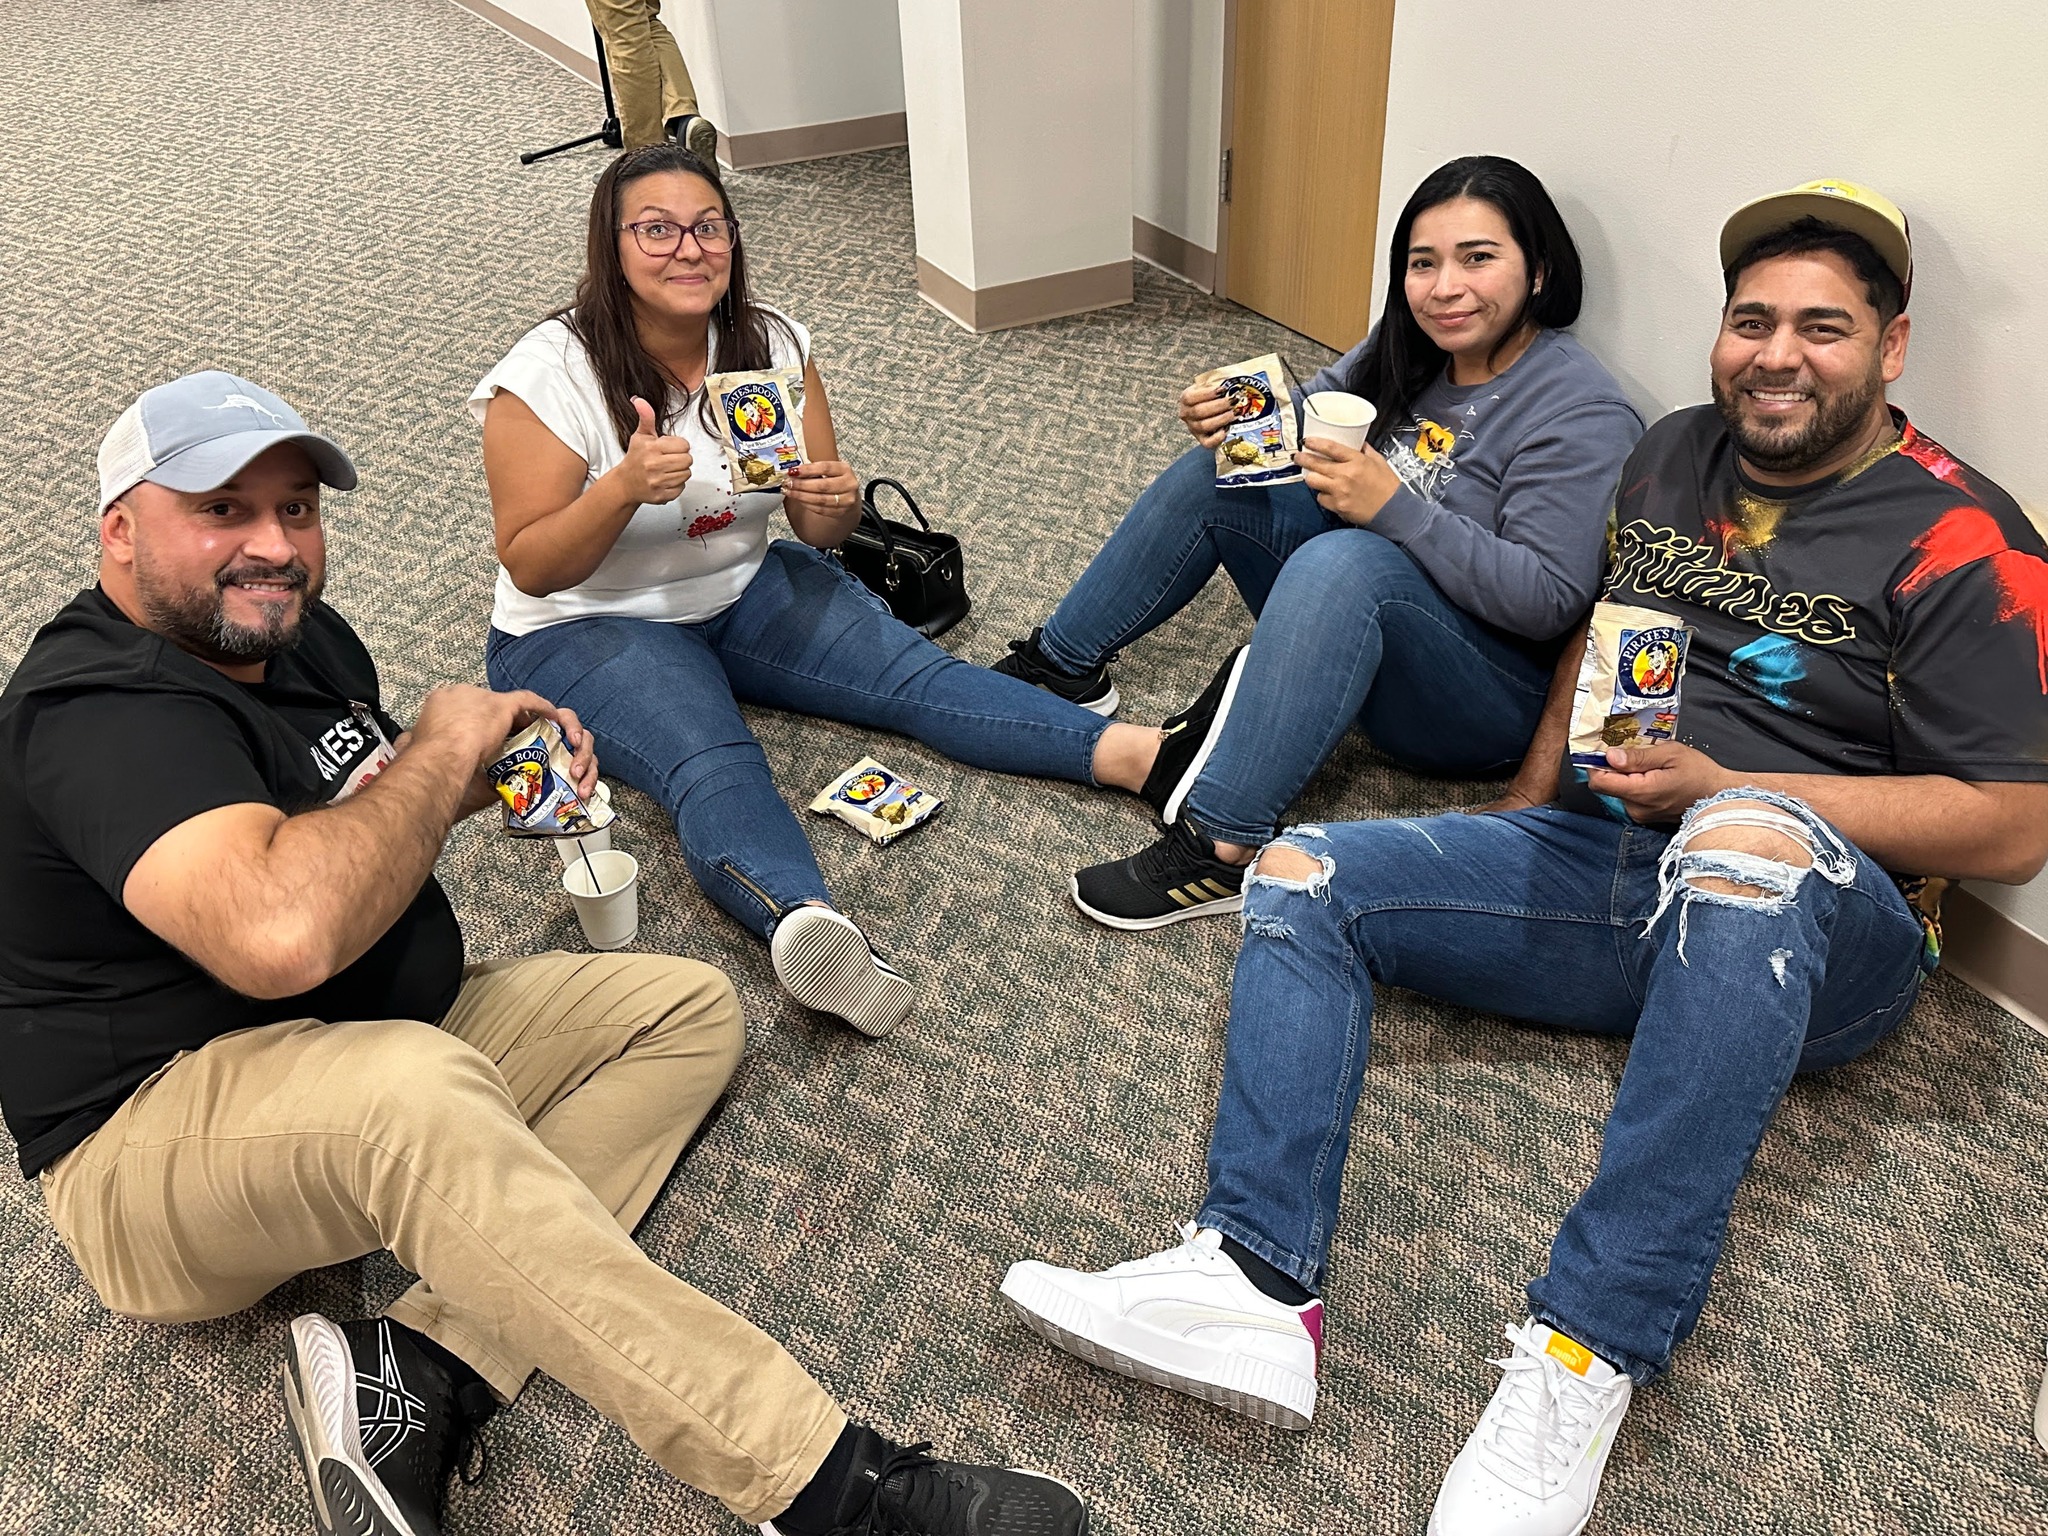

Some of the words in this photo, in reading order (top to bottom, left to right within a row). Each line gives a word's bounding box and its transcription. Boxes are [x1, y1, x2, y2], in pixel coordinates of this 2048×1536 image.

[752, 385, 781, 406] BOOTY
[1623, 629, 1670, 660] PIRATE'S
[515, 750, 548, 765] BOOTY
[1549, 1345, 1578, 1367] PUMA
